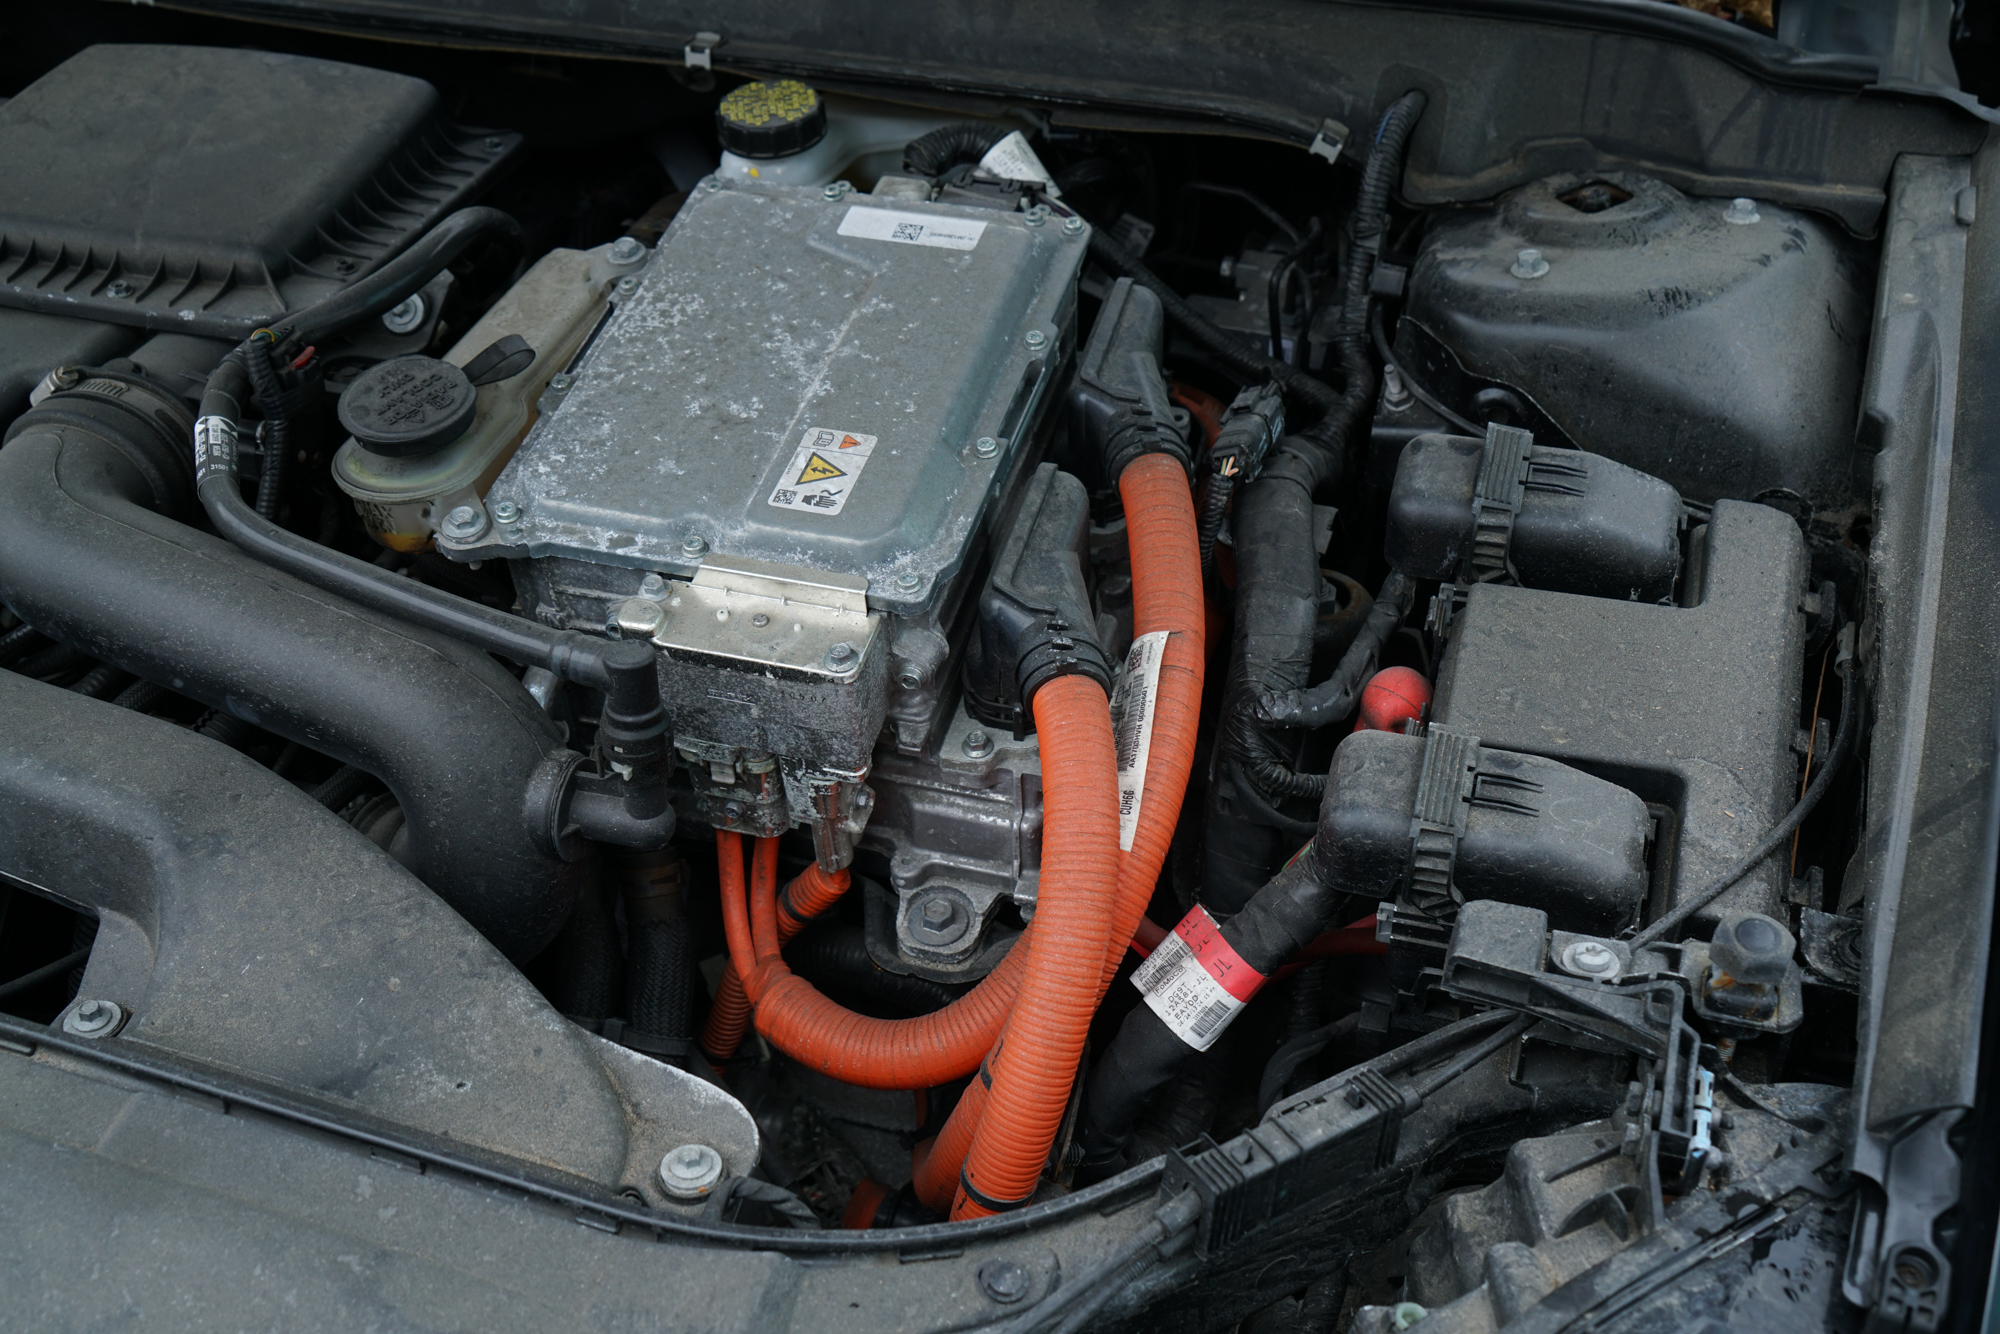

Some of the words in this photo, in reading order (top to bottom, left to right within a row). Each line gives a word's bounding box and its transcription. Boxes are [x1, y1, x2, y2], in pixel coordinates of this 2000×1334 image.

[377, 373, 443, 417] COOLANT
[383, 379, 457, 426] RADIATOR
[1154, 967, 1184, 995] FoMoCo
[1213, 958, 1233, 978] JL
[1163, 972, 1207, 1016] 12A581-JL
[1167, 981, 1188, 1002] DG9T
